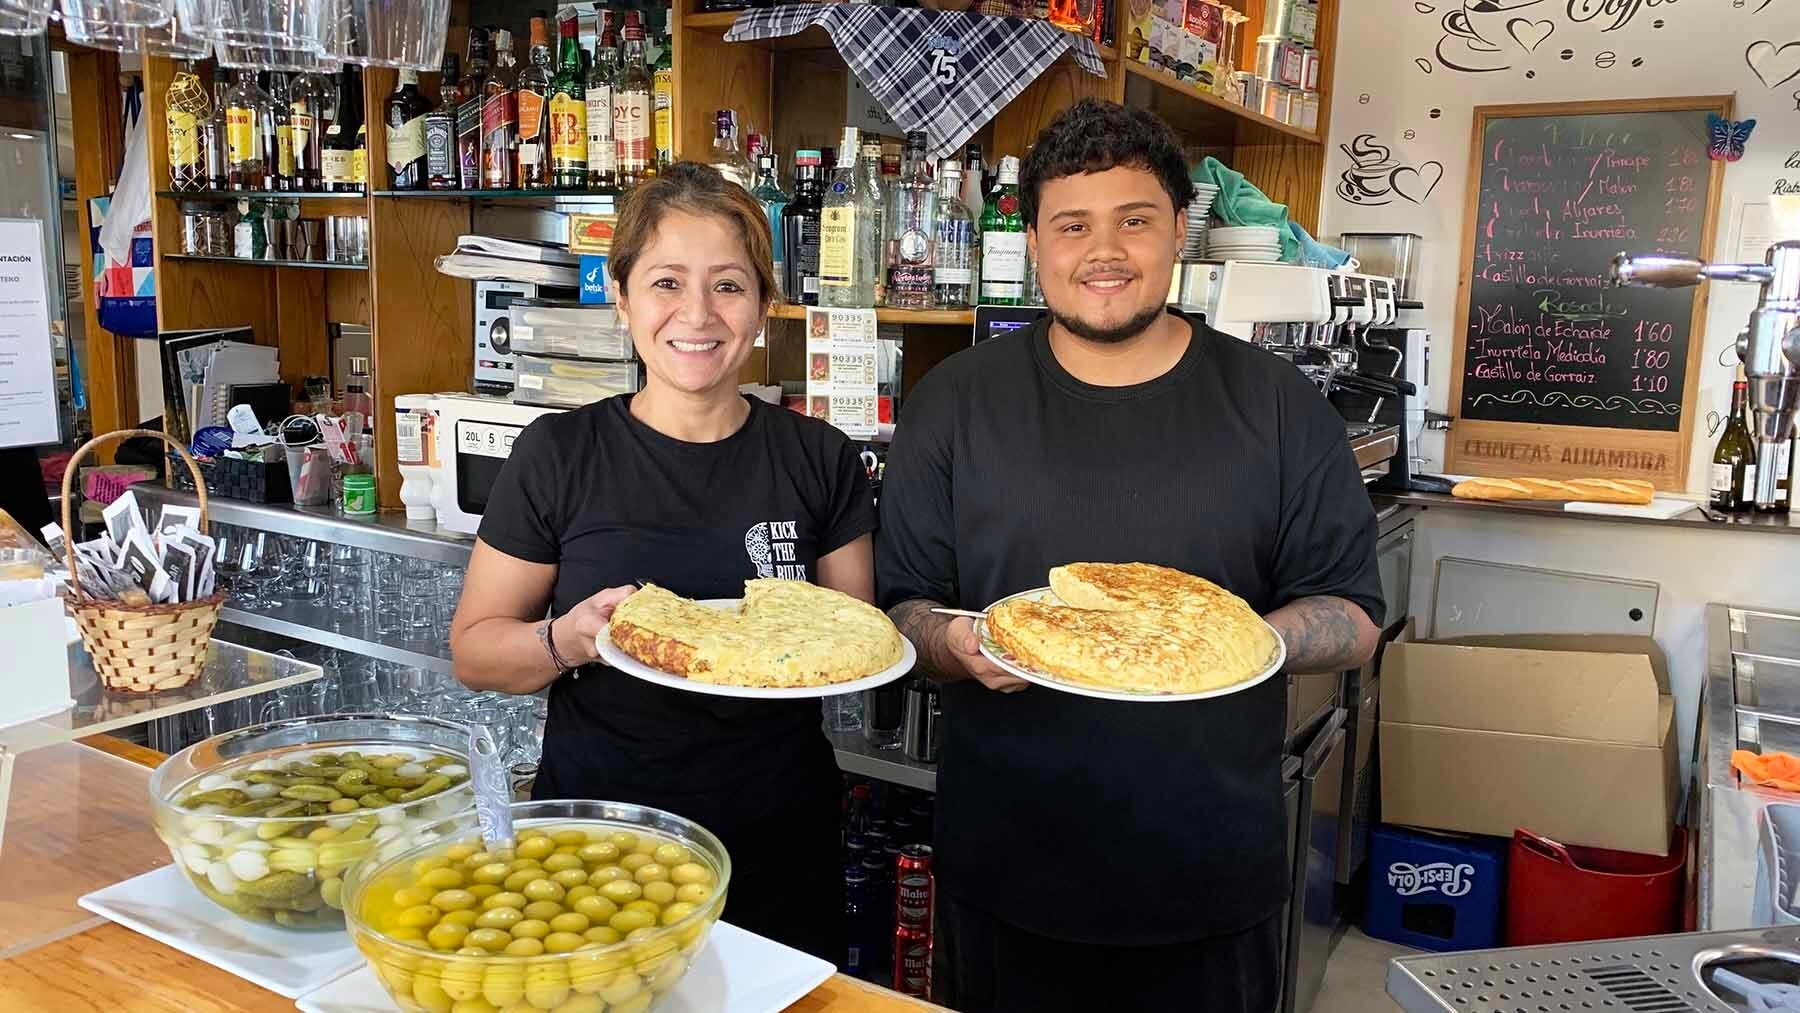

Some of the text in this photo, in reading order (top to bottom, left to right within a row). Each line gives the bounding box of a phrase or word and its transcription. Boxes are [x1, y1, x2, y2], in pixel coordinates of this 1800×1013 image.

[465, 431, 481, 442] 20L
[769, 521, 799, 540] KICK
[772, 543, 796, 561] THE
